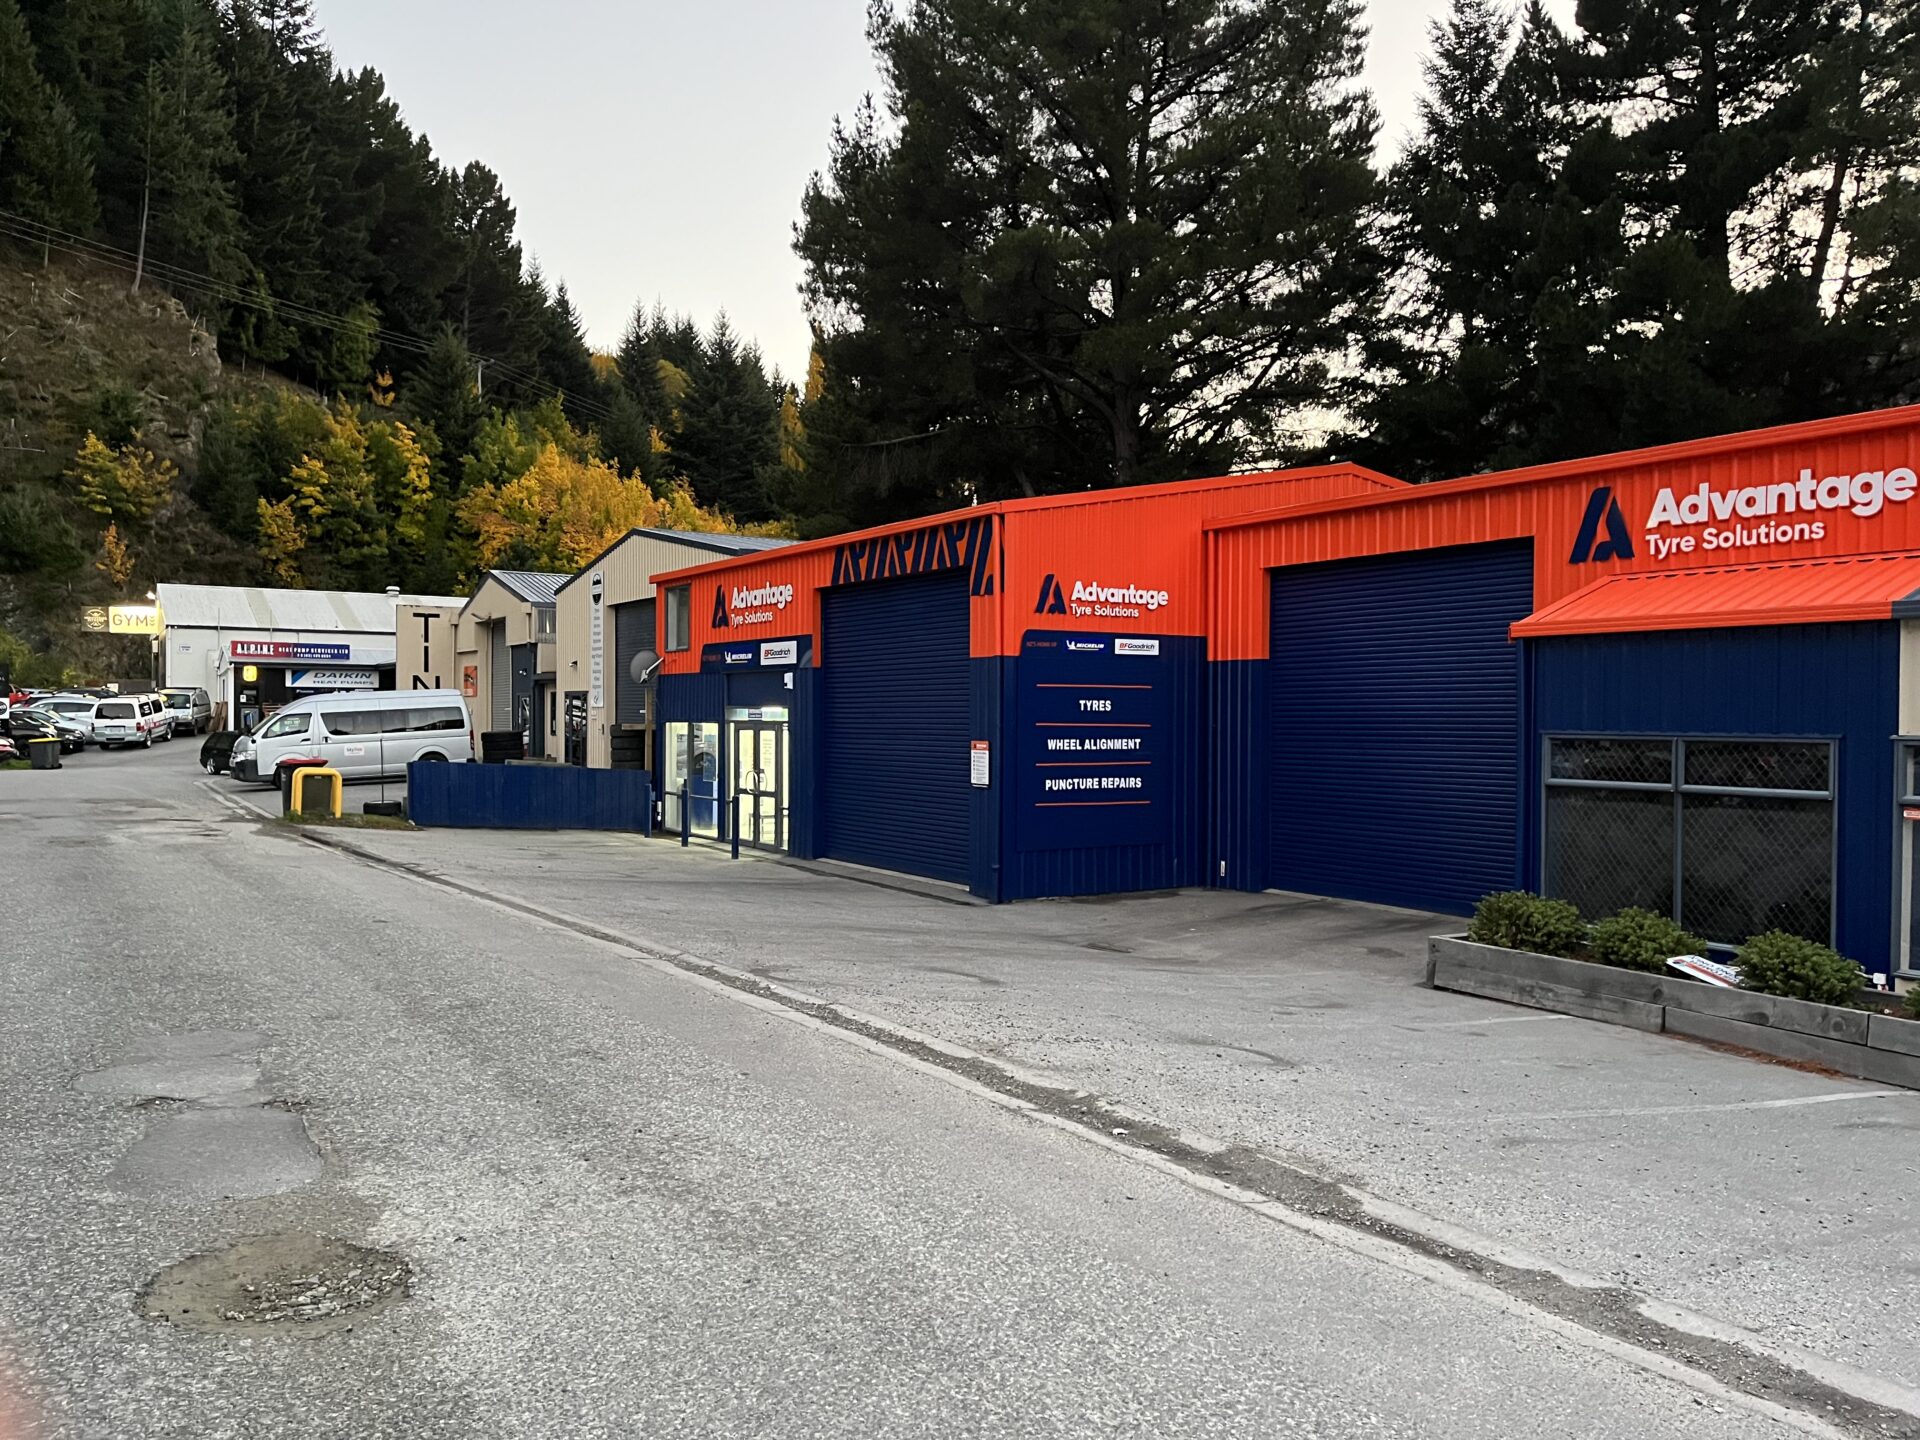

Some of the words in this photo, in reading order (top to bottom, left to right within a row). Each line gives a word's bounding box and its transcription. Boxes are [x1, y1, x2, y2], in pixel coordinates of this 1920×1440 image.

[1645, 467, 1918, 529] Advantage
[1645, 533, 1696, 560] Tyre
[1702, 521, 1825, 550] Solutions
[731, 580, 793, 610] Advantage
[1070, 580, 1169, 610] Advantage
[1070, 603, 1093, 617] Tyre
[1094, 604, 1140, 618] Solutions
[112, 613, 149, 627] GYM
[730, 613, 744, 628] Tyre
[744, 610, 773, 624] Solutions
[1118, 642, 1155, 650] BFGoodrich
[1079, 700, 1112, 712] TYRES
[1047, 738, 1082, 751] WHEEL
[1084, 738, 1141, 750] ALIGNMENT
[1045, 777, 1100, 791] PUNCTURE
[1101, 777, 1142, 789] REPAIRS
